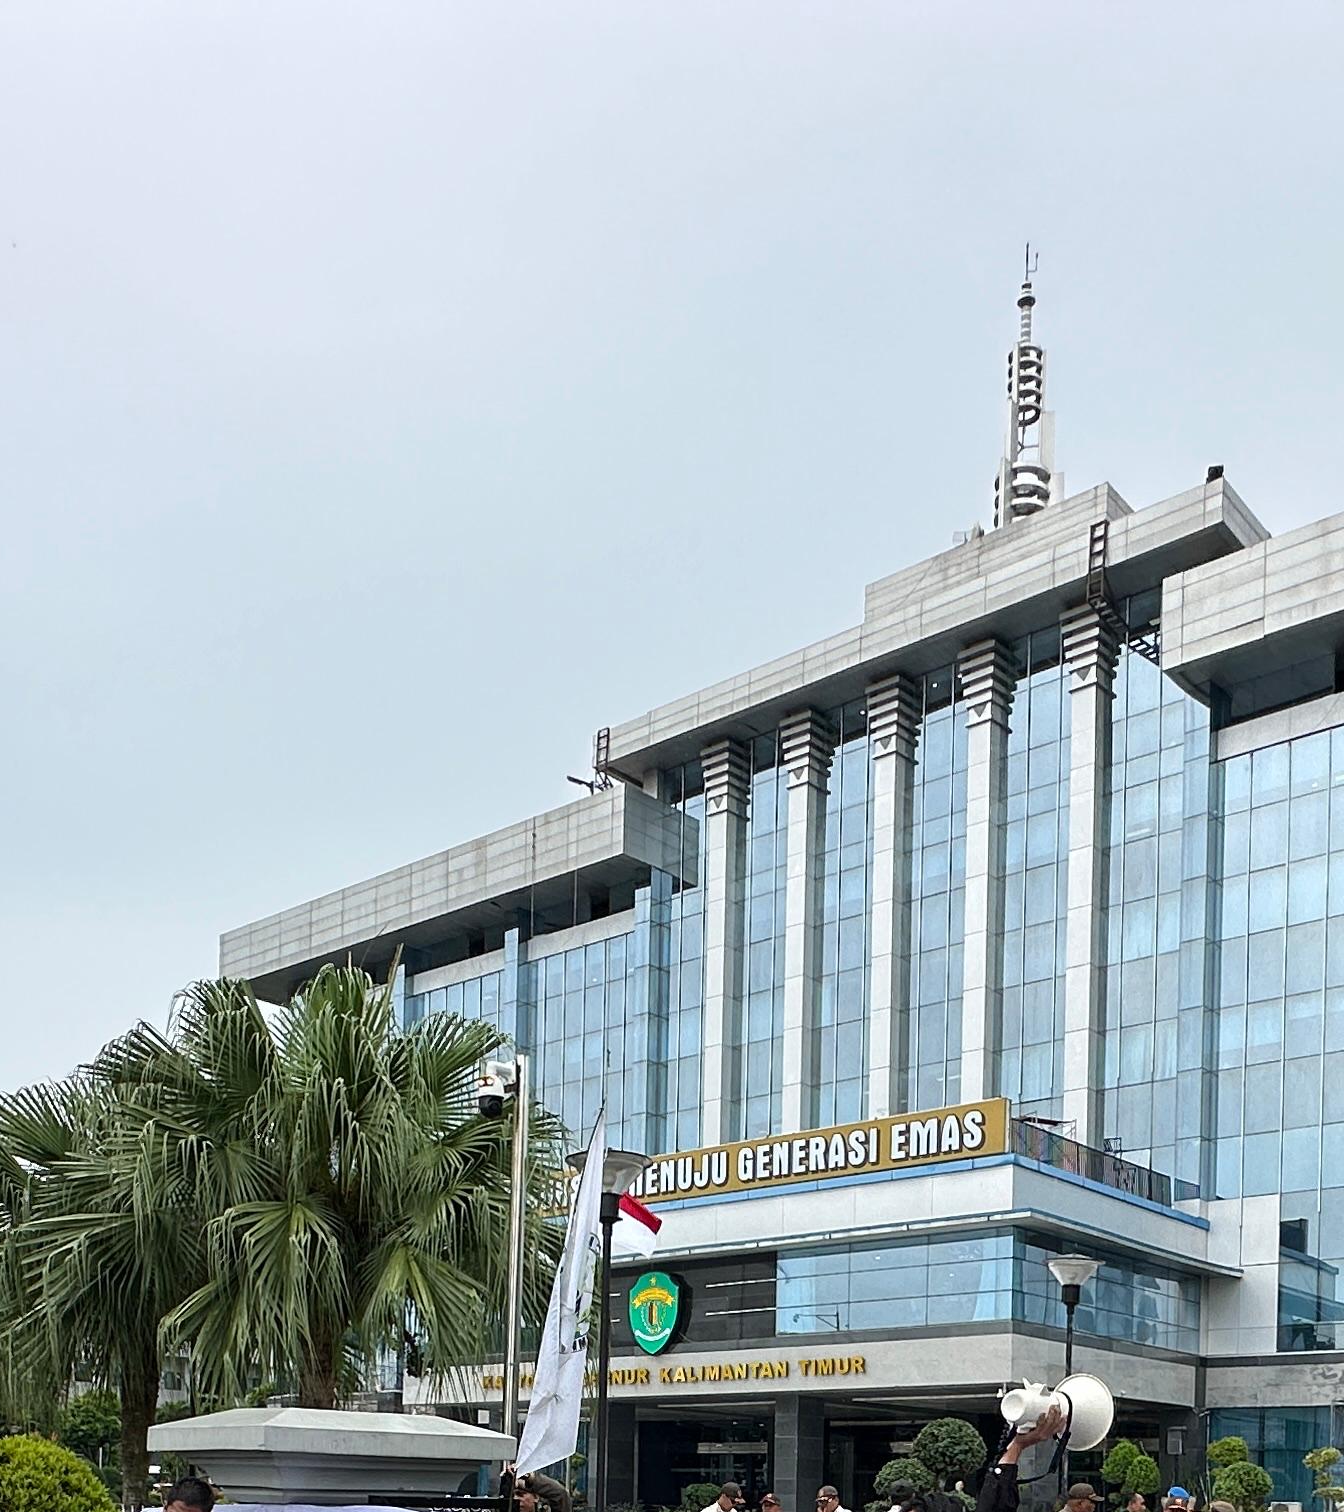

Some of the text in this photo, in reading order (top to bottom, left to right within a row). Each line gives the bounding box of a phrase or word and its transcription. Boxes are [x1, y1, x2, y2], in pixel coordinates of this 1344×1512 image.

[737, 1130, 879, 1183] GENERASI
[889, 1110, 987, 1163] EMAS
[659, 1361, 789, 1384] KALIMANTAN
[798, 1356, 867, 1376] TIMUR
